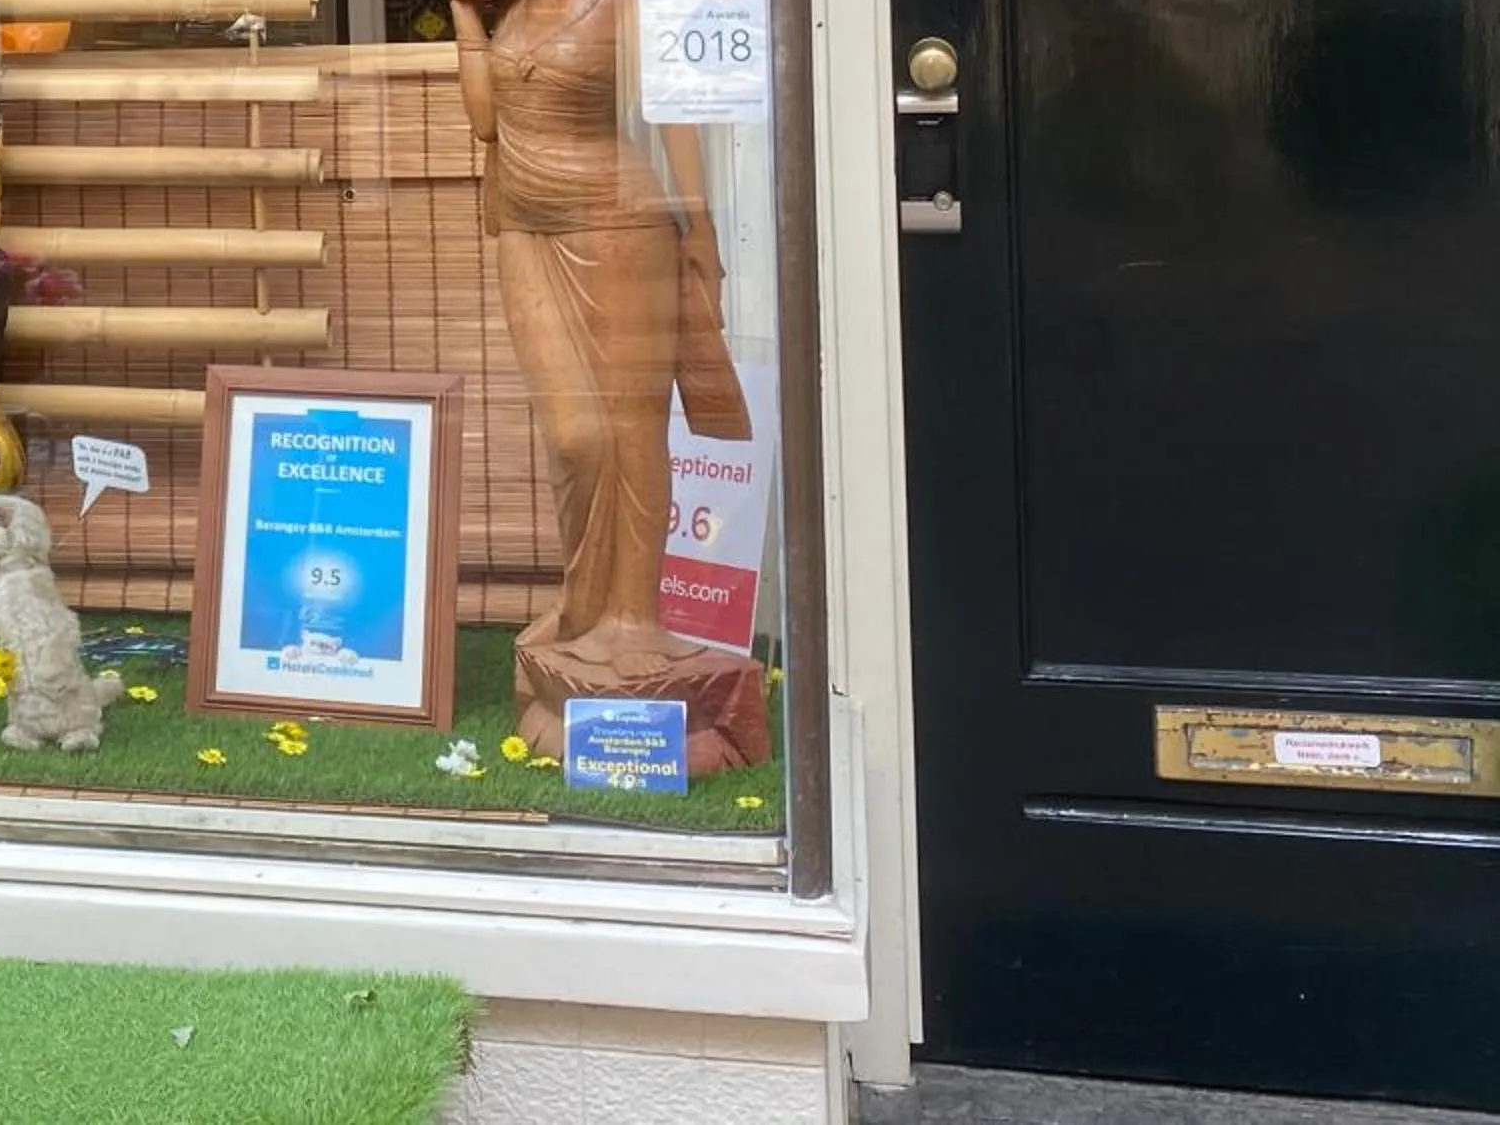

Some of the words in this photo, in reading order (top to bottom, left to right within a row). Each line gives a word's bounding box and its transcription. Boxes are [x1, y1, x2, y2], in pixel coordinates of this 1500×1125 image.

[657, 28, 752, 64] 2018
[270, 431, 396, 454] RECOGNITION
[278, 462, 386, 485] EXCELLENCE
[670, 455, 752, 483] eptional
[310, 567, 342, 587] 9.5
[659, 574, 730, 605] els.com
[577, 756, 677, 776] Exceptional
